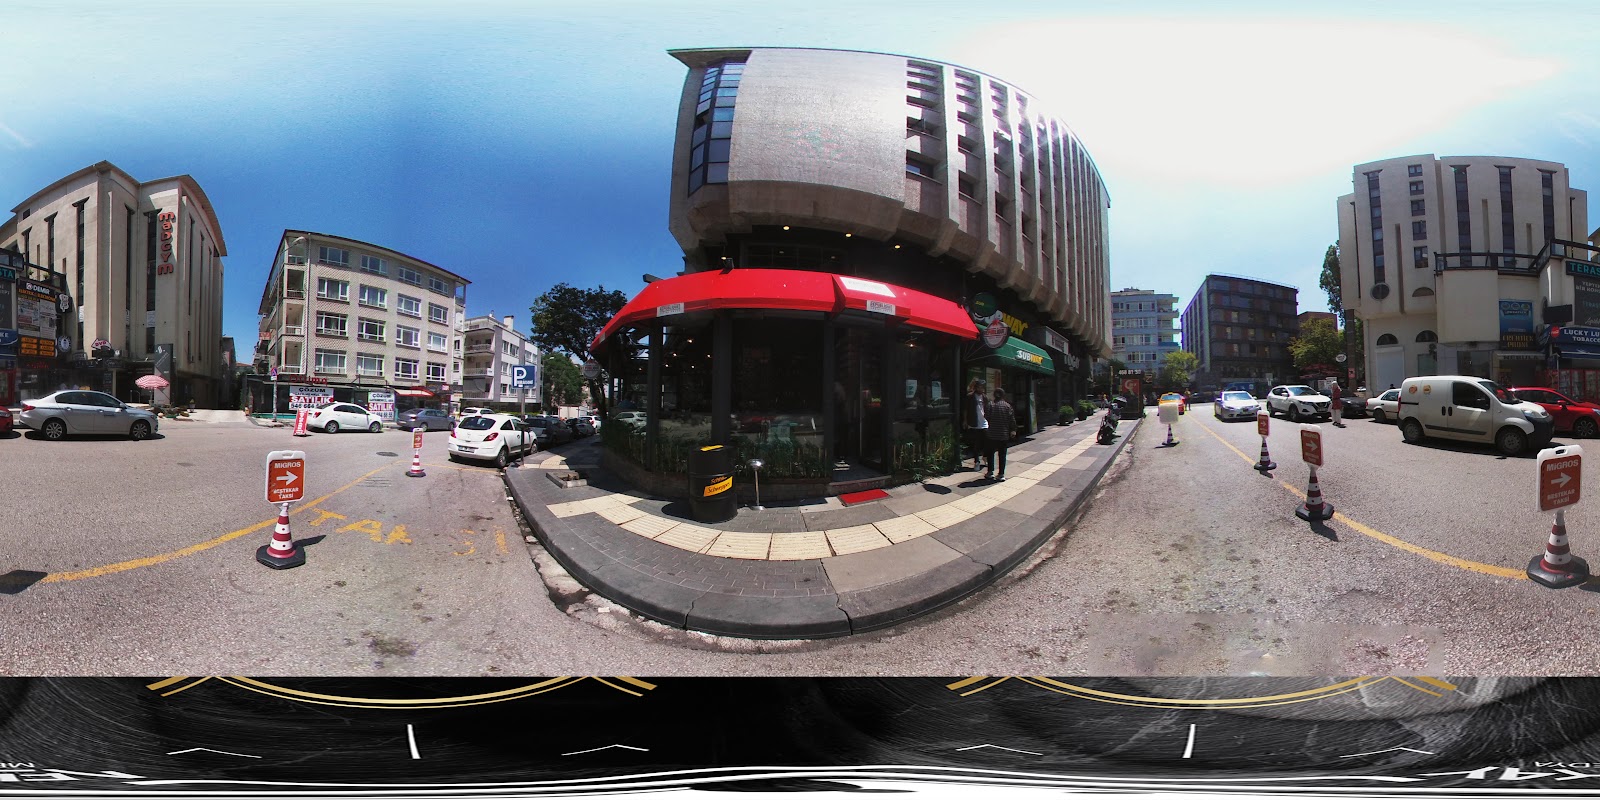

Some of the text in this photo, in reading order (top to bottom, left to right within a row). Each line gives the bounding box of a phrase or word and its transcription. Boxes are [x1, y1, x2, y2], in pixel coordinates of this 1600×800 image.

[1016, 350, 1043, 364] SUBWAY
[291, 396, 331, 404] SATILIK
[369, 403, 393, 411] SATILIK
